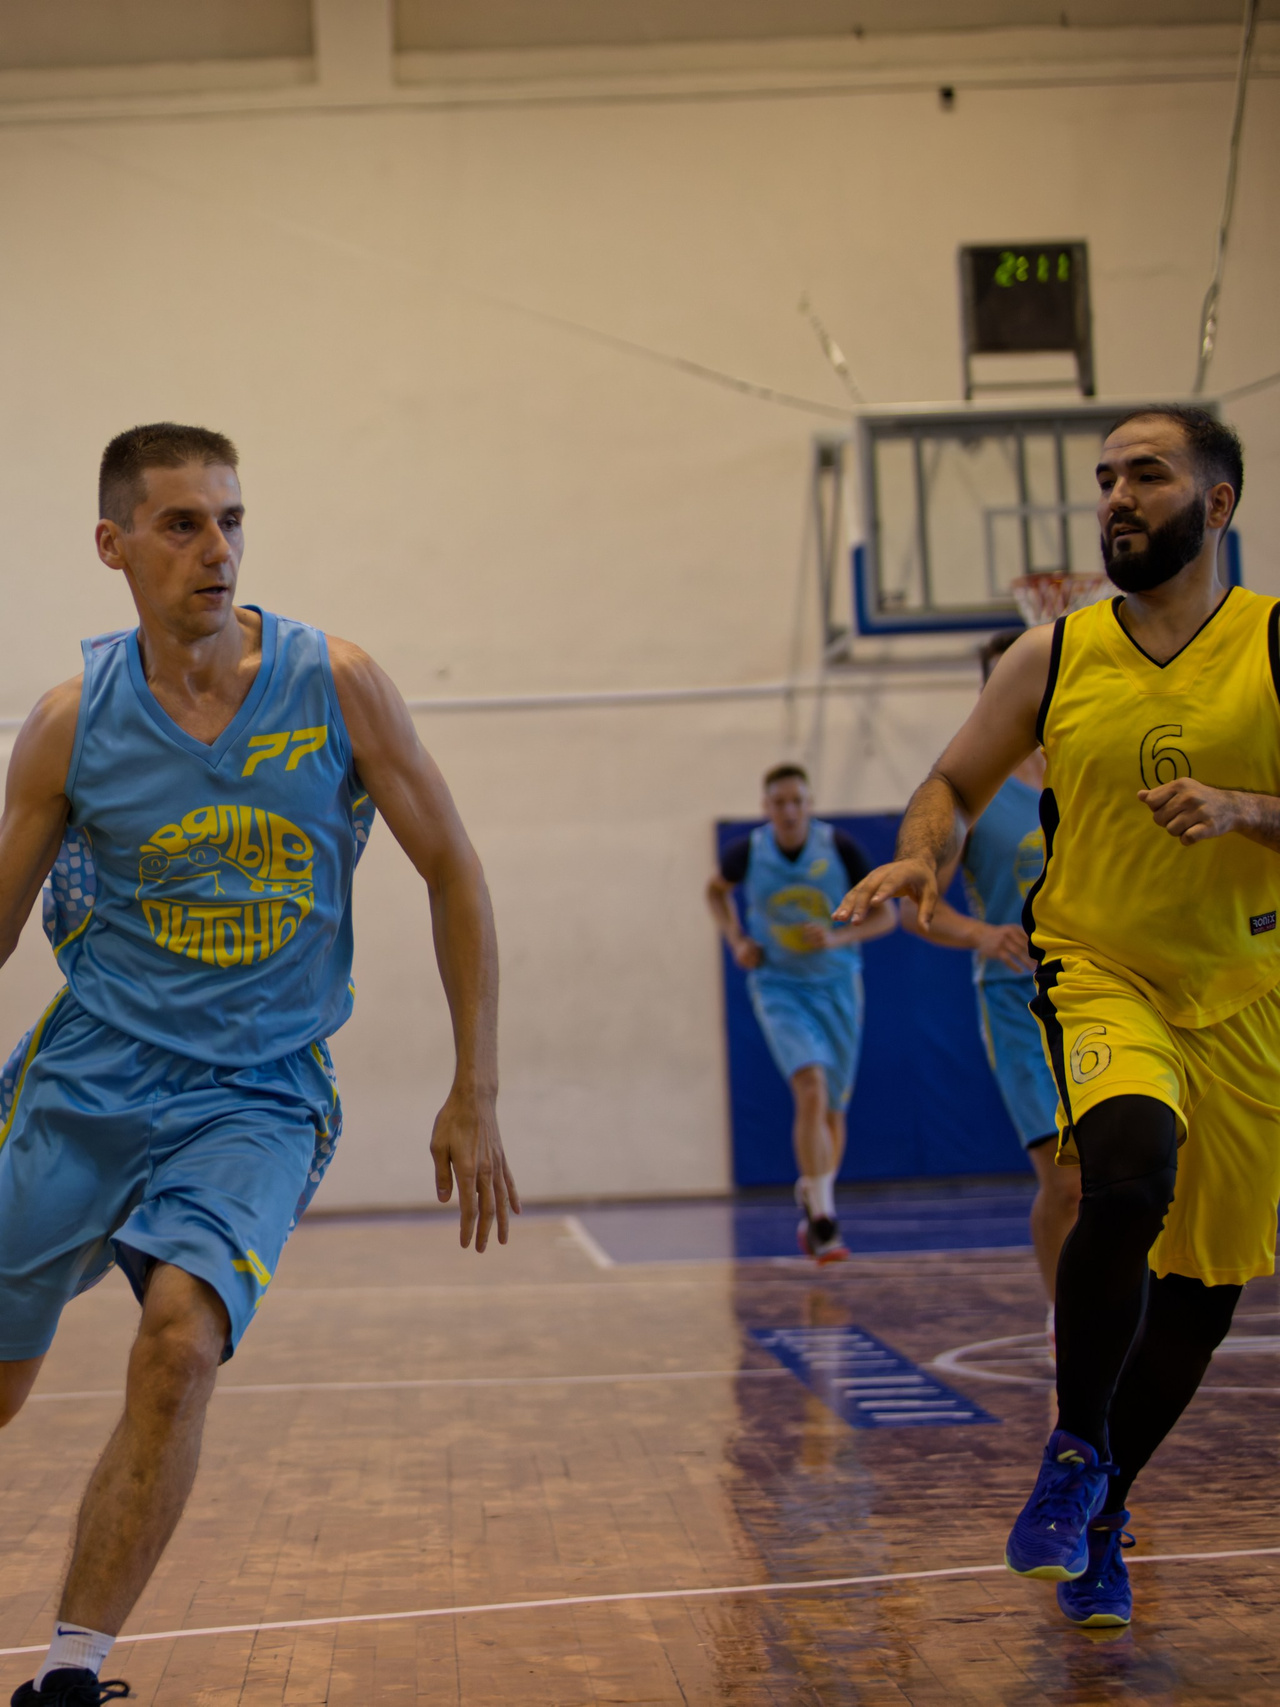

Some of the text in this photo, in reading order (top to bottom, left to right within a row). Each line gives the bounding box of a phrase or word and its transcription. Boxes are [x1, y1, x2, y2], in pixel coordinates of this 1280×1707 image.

[241, 725, 327, 777] 77
[1139, 723, 1192, 791] 6
[1069, 1025, 1112, 1084] 6
